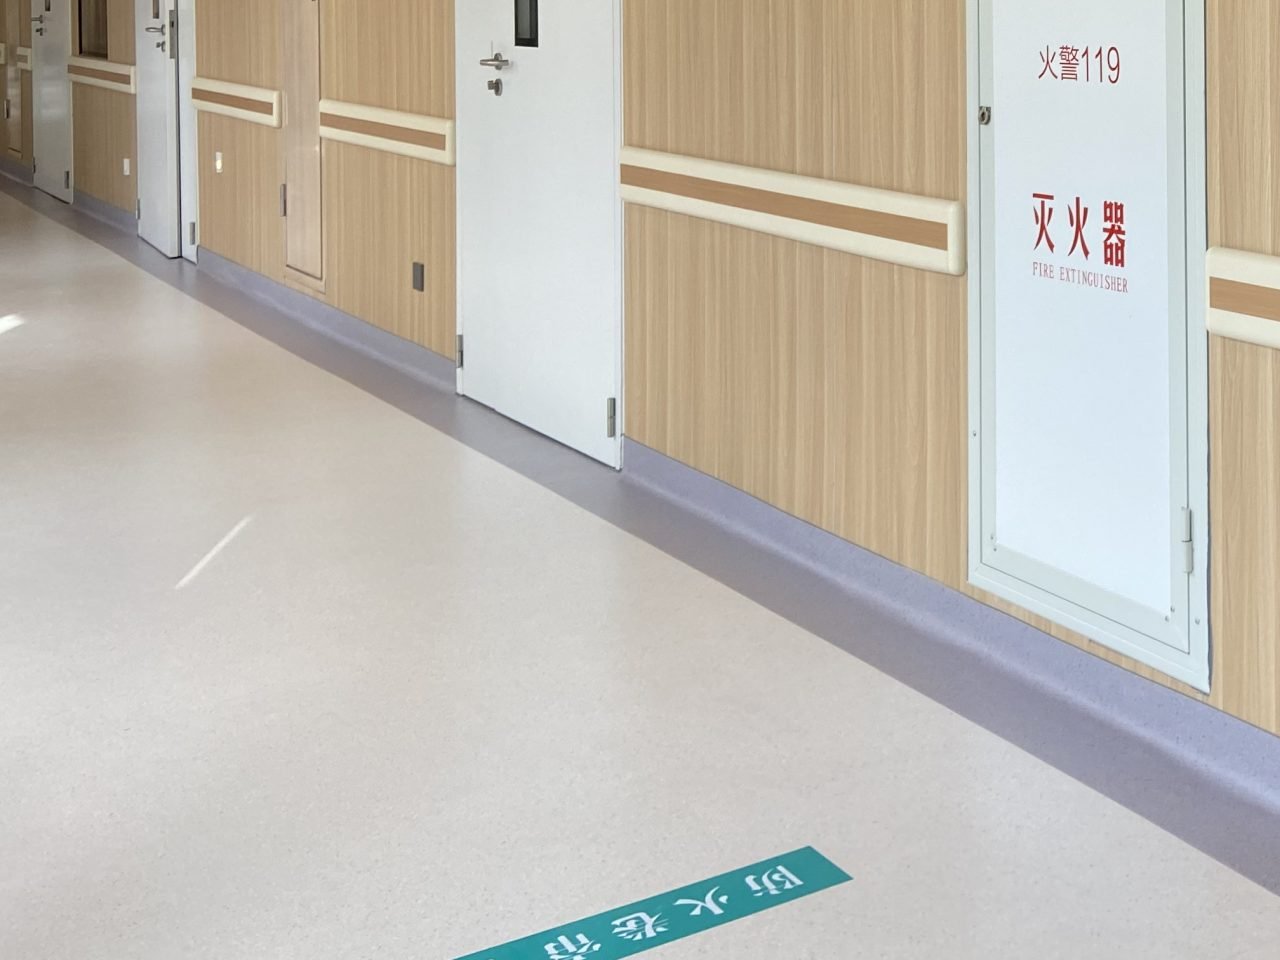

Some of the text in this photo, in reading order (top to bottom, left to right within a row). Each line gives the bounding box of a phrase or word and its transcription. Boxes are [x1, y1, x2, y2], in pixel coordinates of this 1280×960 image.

[1037, 45, 1121, 84] 火警119
[1032, 192, 1126, 268] 灭火器
[1032, 261, 1128, 293] FIRE EXTINGUISHER
[543, 865, 804, 960] 防火卷帘
